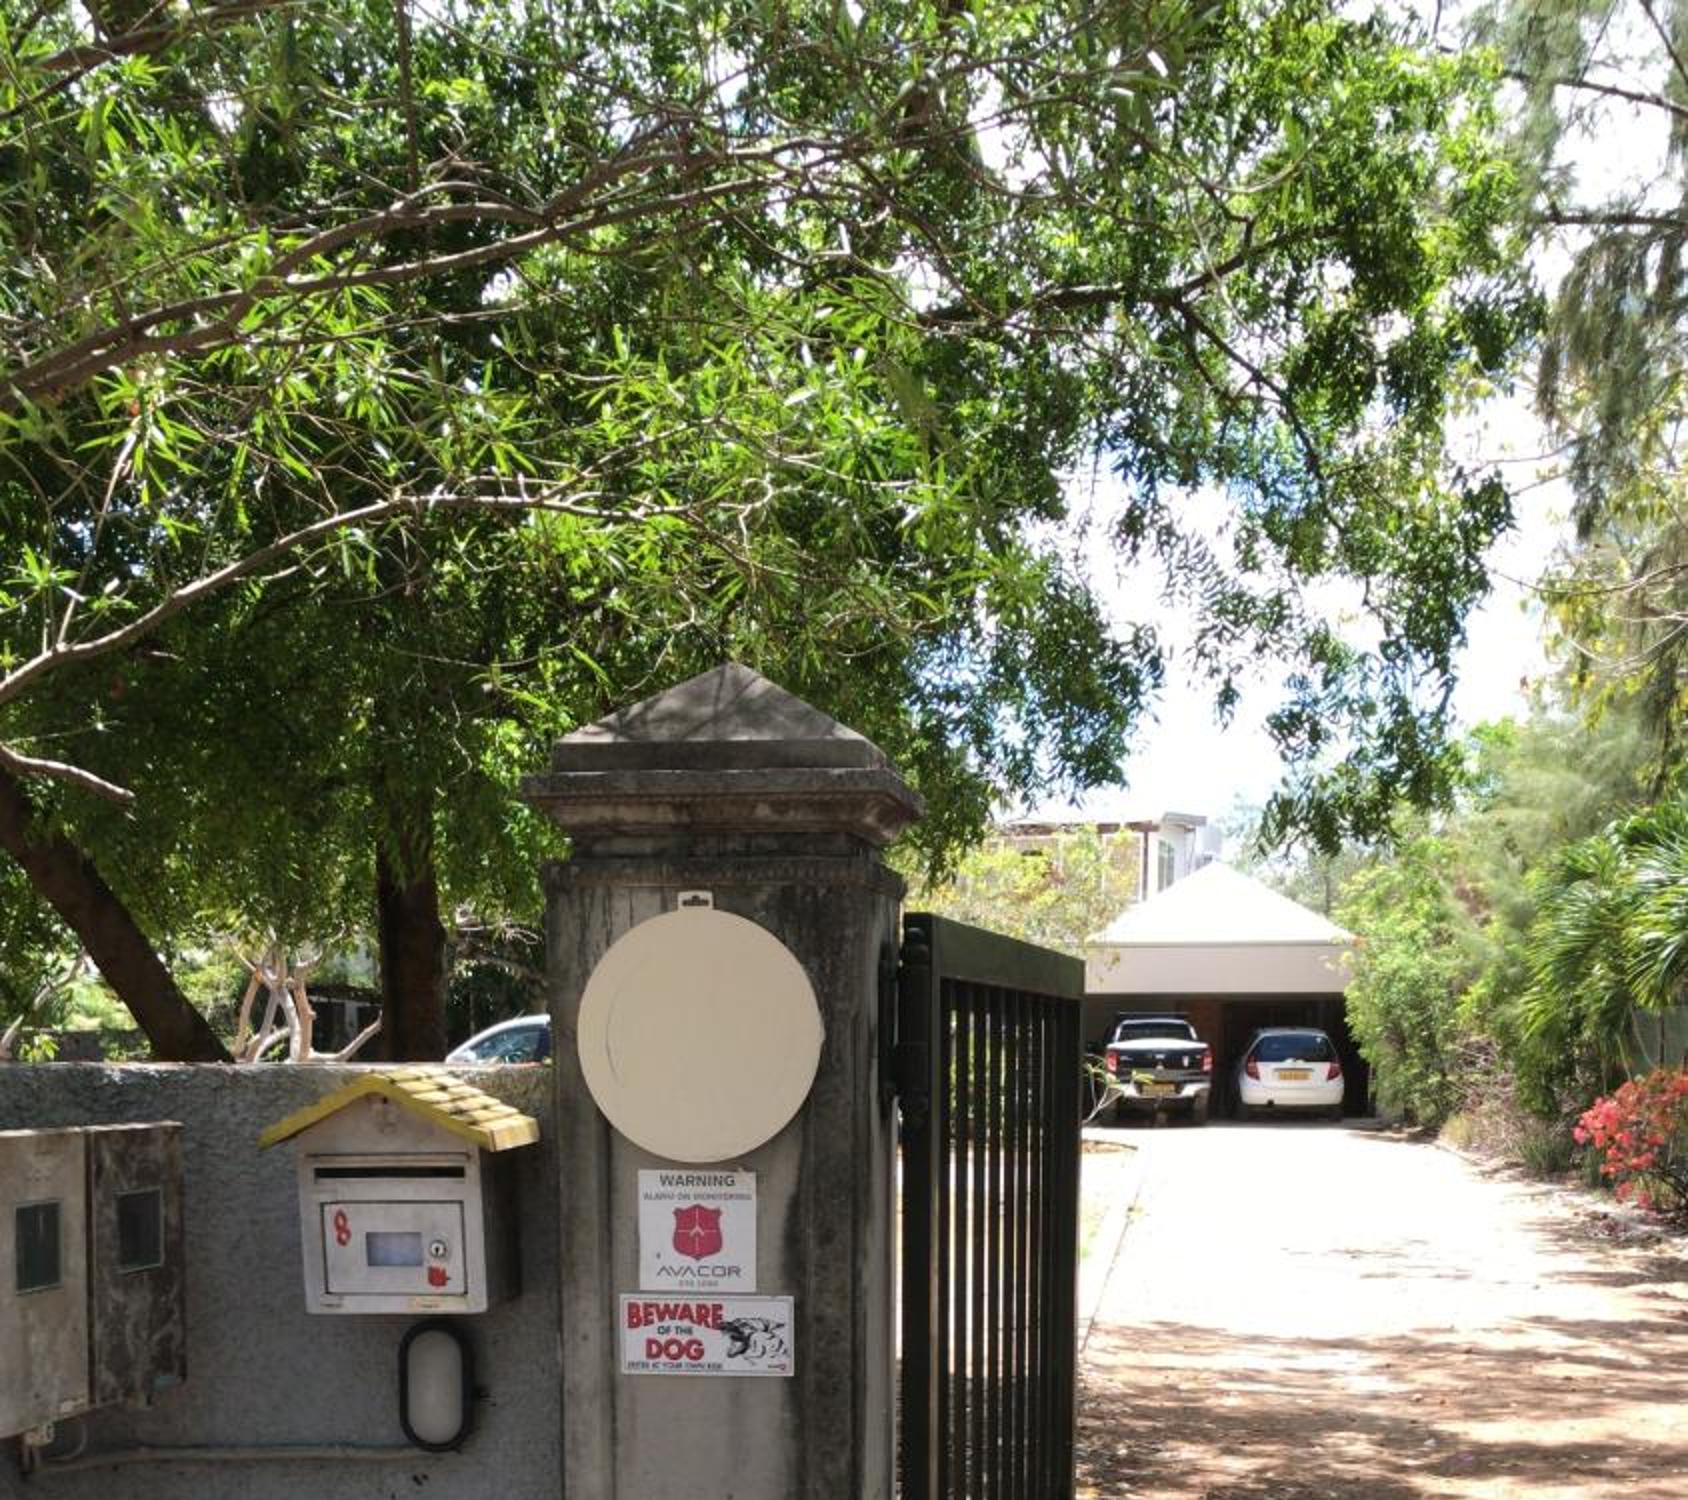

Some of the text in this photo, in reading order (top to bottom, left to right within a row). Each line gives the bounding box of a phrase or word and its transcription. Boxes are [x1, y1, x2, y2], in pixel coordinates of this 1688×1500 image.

[659, 1174, 736, 1187] WARNING
[334, 1209, 351, 1246] 8
[656, 1265, 742, 1277] AVACOR
[627, 1302, 723, 1330] BEWARE
[657, 1326, 693, 1335] OF THE
[645, 1338, 705, 1360] DOG
